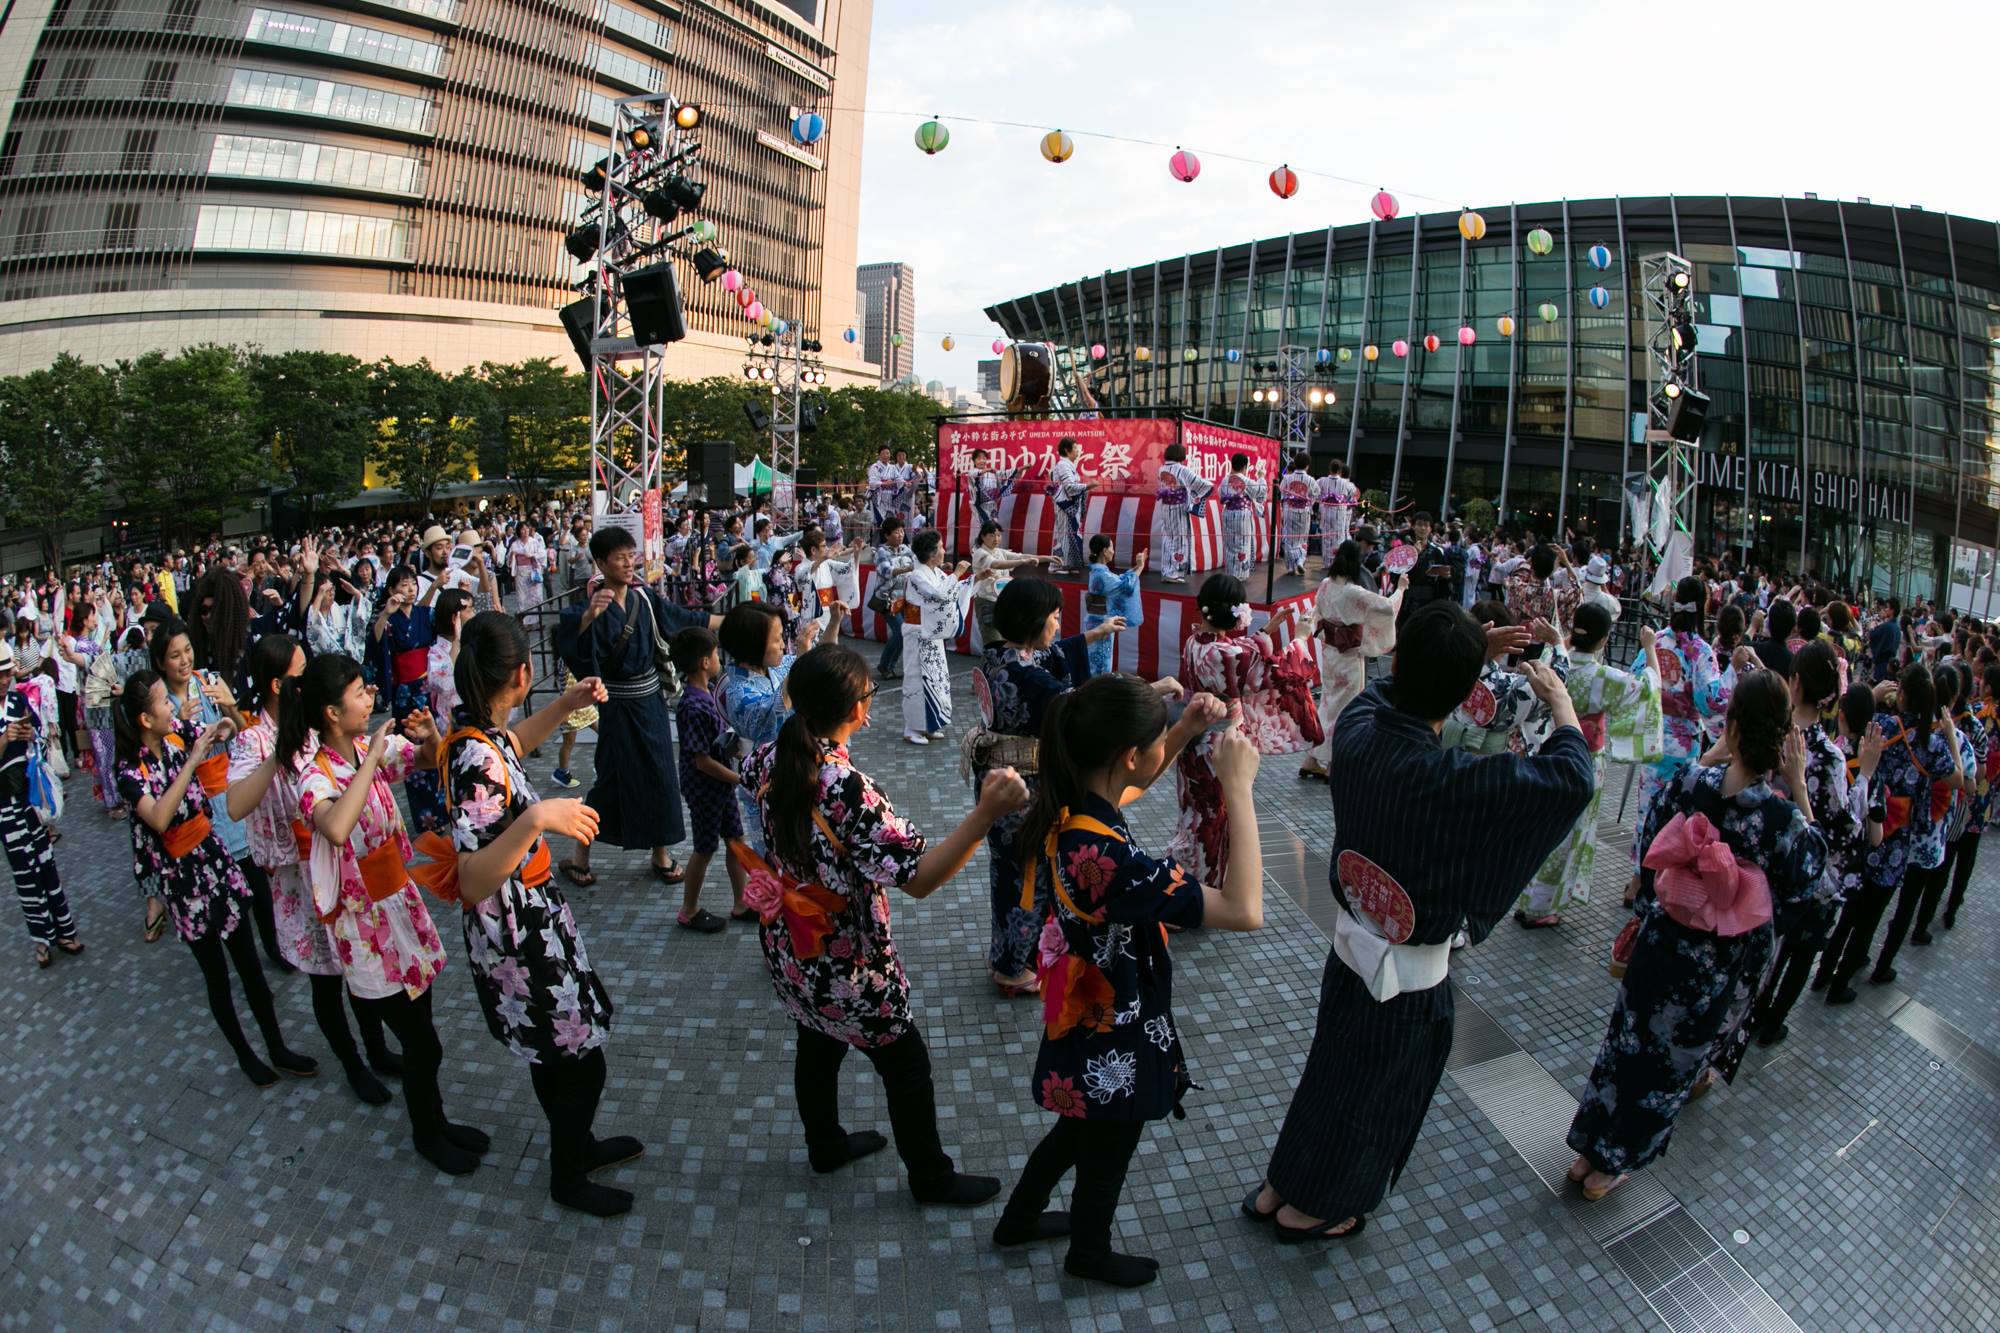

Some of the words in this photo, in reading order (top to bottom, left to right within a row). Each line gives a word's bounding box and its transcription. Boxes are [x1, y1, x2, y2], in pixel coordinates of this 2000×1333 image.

[1077, 430, 1105, 438] MATSURI
[1757, 460, 1801, 501] KITA
[1814, 471, 1859, 512] SHIP
[1868, 482, 1911, 525] HALL
